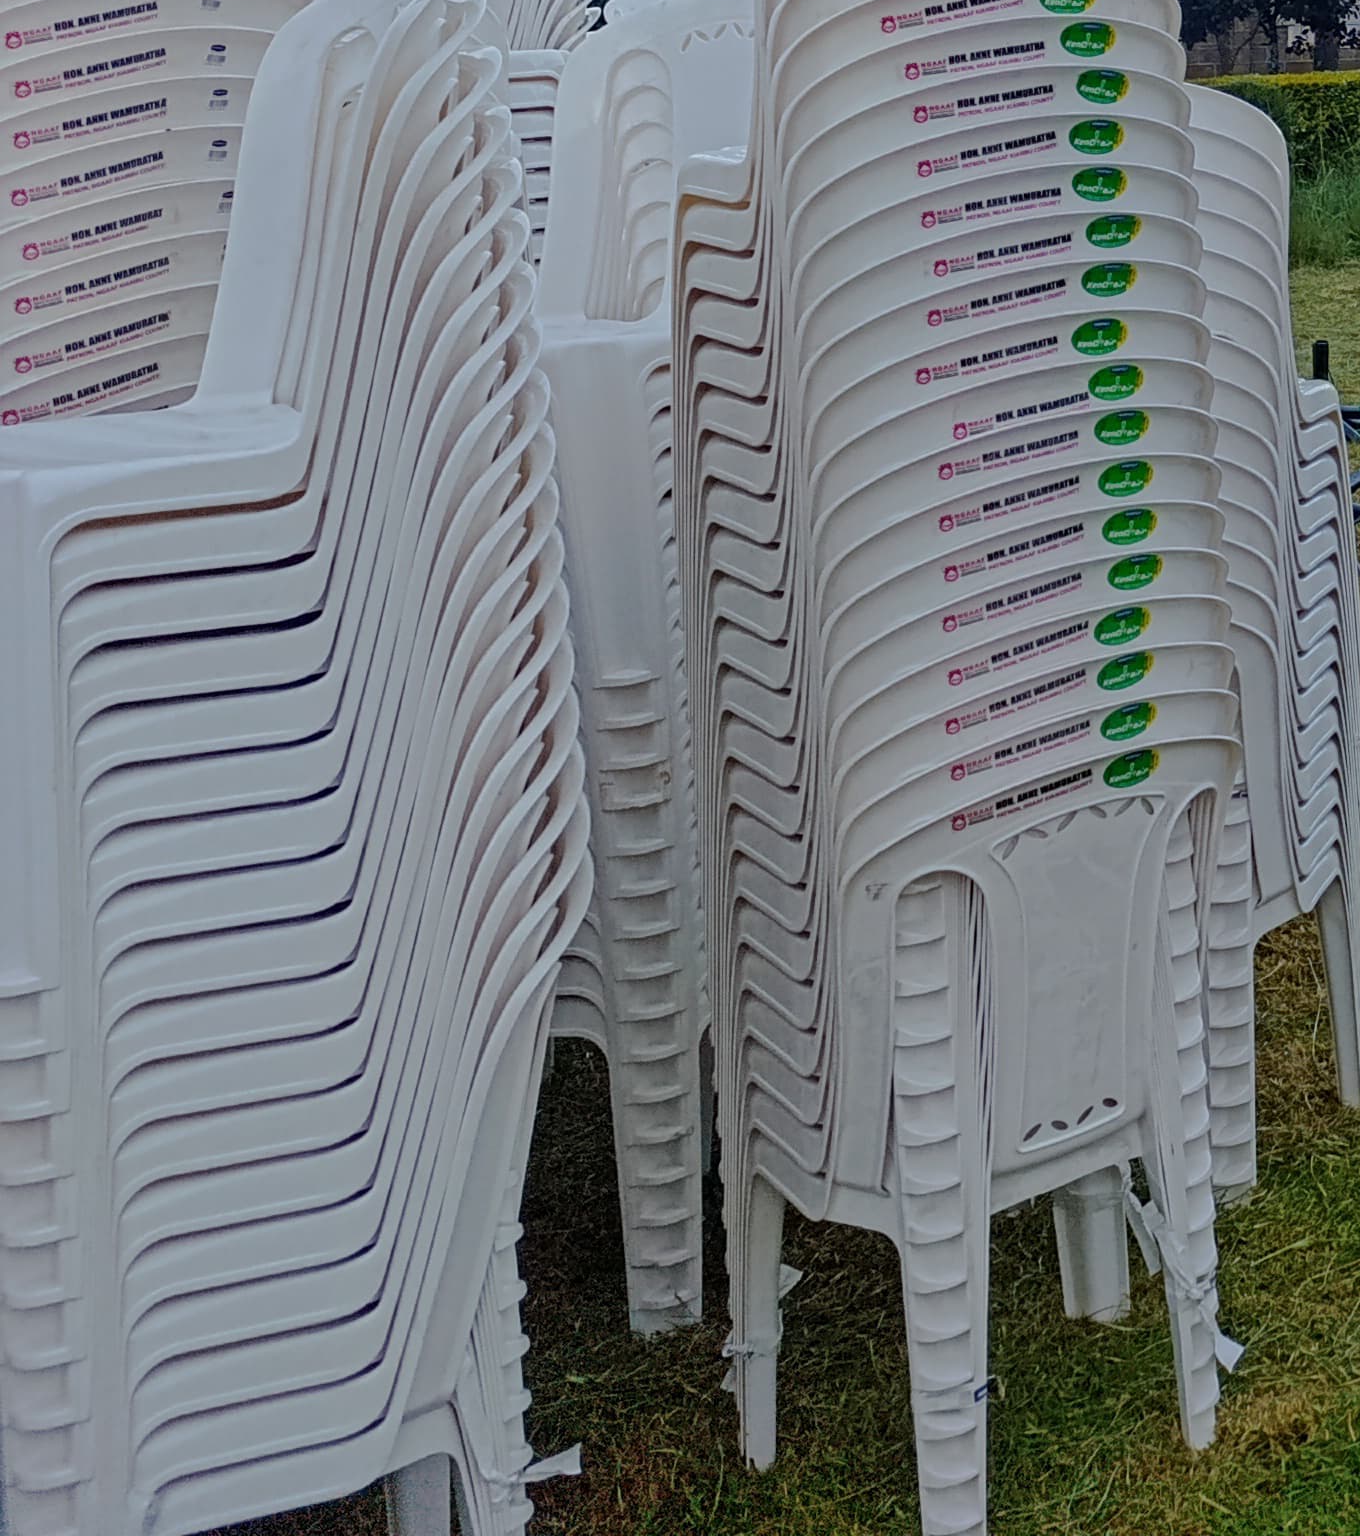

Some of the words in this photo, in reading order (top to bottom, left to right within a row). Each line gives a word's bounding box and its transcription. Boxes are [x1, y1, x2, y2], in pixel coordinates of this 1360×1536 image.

[78, 14, 100, 27] ANNE
[102, 1, 158, 21] WAMURATHA
[946, 0, 968, 12] ANNE
[86, 61, 109, 75] ANNE
[110, 48, 166, 69] WAMURATHA
[970, 49, 991, 61] ANNE
[992, 41, 1045, 57] WAMURATHA
[978, 93, 1000, 105] ANNE
[1001, 84, 1054, 101] WAMURATHA
[85, 112, 108, 126] ANNE
[110, 98, 167, 120] WAMURATHA
[981, 143, 1002, 155] ANNE
[1004, 130, 1056, 150] WAMURATHA
[84, 167, 107, 182] ANNE
[108, 151, 164, 174] WAMURATHA
[986, 196, 1007, 208] ANNE
[1009, 187, 1061, 204] WAMURATHA
[94, 221, 117, 235] ANNE
[998, 245, 1018, 257] ANNE
[1020, 233, 1072, 252] WAMURATHA
[88, 274, 112, 288] ANNE
[113, 257, 169, 281] WAMURATHA
[992, 291, 1012, 304] ANNE
[1014, 278, 1066, 298] WAMURATHA
[88, 330, 112, 346] ANNE
[982, 349, 1003, 362] ANNE
[1005, 335, 1058, 356] WAMURATHA
[77, 383, 101, 399] ANNE
[101, 362, 159, 390] WAMURATHA
[1016, 405, 1038, 417] ANNE
[1038, 391, 1089, 412] WAMURATHA
[1003, 444, 1025, 457] ANNE
[1026, 430, 1078, 451] WAMURATHA
[1004, 492, 1025, 506] ANNE
[1027, 475, 1080, 499] WAMURATHA
[1008, 541, 1030, 555] ANNE
[1032, 522, 1084, 547] WAMURATHA
[1007, 590, 1028, 605] ANNE
[1030, 572, 1082, 597] WAMURATHA
[1013, 641, 1034, 656] ANNE
[1010, 690, 1032, 704] ANNE
[1016, 738, 1036, 752] ANNE
[1038, 720, 1090, 745] WAMURATHA
[1017, 788, 1038, 802] ANNE
[1040, 768, 1092, 794] WAMURATHA
